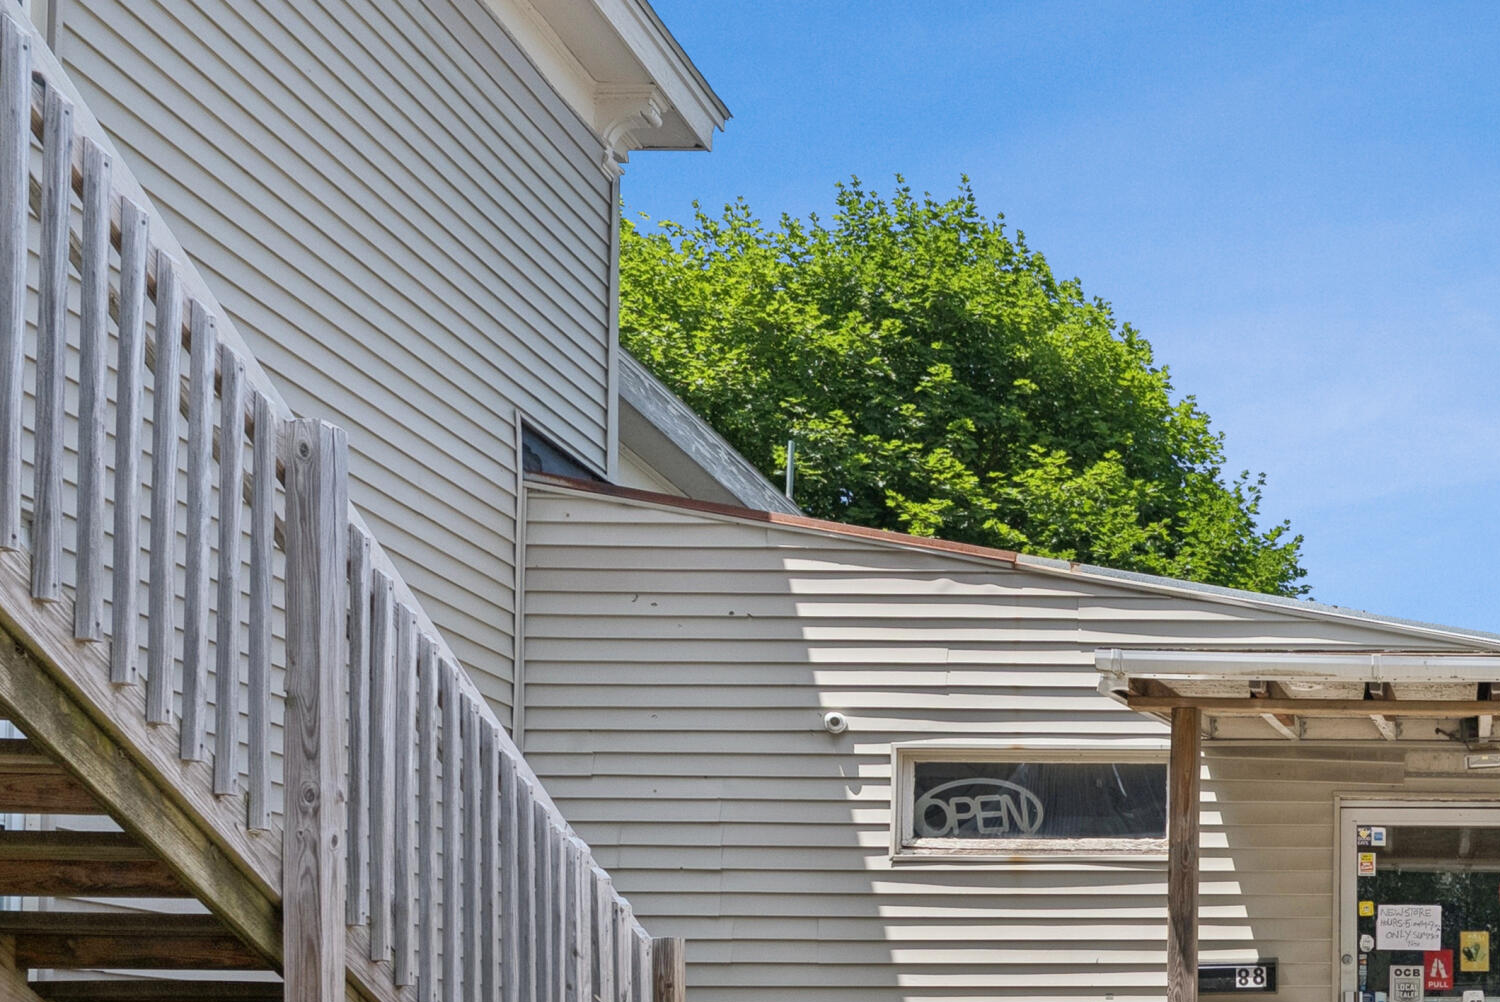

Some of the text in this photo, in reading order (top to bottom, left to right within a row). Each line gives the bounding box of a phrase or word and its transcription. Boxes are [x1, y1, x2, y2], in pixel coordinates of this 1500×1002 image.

[918, 795, 1033, 836] OPEN
[1380, 907, 1432, 917] NEW STORE
[1385, 929, 1411, 941] ONLY
[1237, 966, 1265, 986] 88
[1394, 968, 1420, 977] OCB
[1395, 983, 1417, 991] LOCAL
